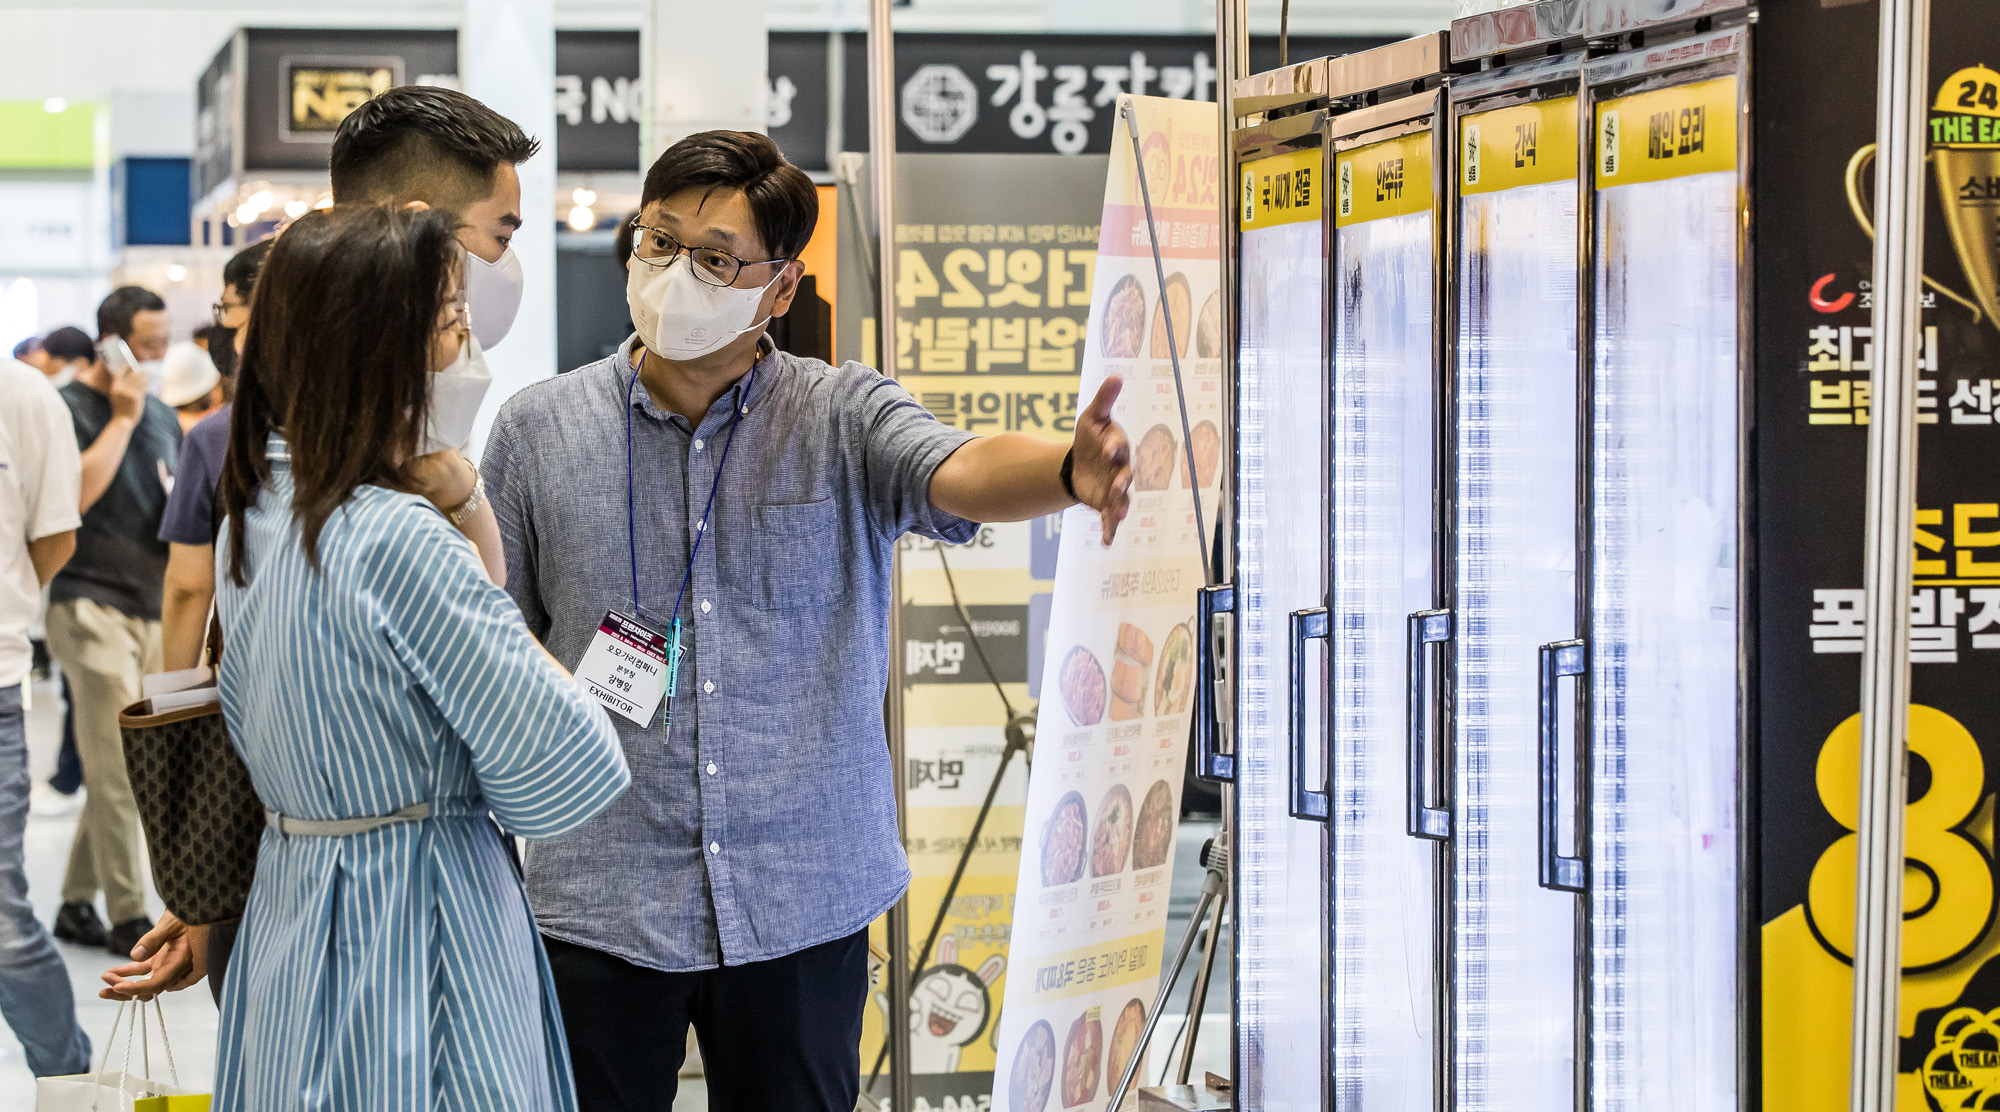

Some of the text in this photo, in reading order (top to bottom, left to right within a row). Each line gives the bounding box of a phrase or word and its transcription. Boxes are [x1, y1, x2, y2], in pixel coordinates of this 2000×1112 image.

[1958, 80, 1998, 110] 24
[1514, 121, 1537, 168] 간식
[1648, 104, 1705, 160] 메인 요리
[1930, 116, 1974, 142] THE
[1376, 157, 1404, 202] 안주류
[1948, 379, 2000, 425] 선
[606, 644, 658, 676] 오모가리컴퍼니
[589, 685, 633, 714] EXHIBITOR
[1808, 703, 1994, 968] 8
